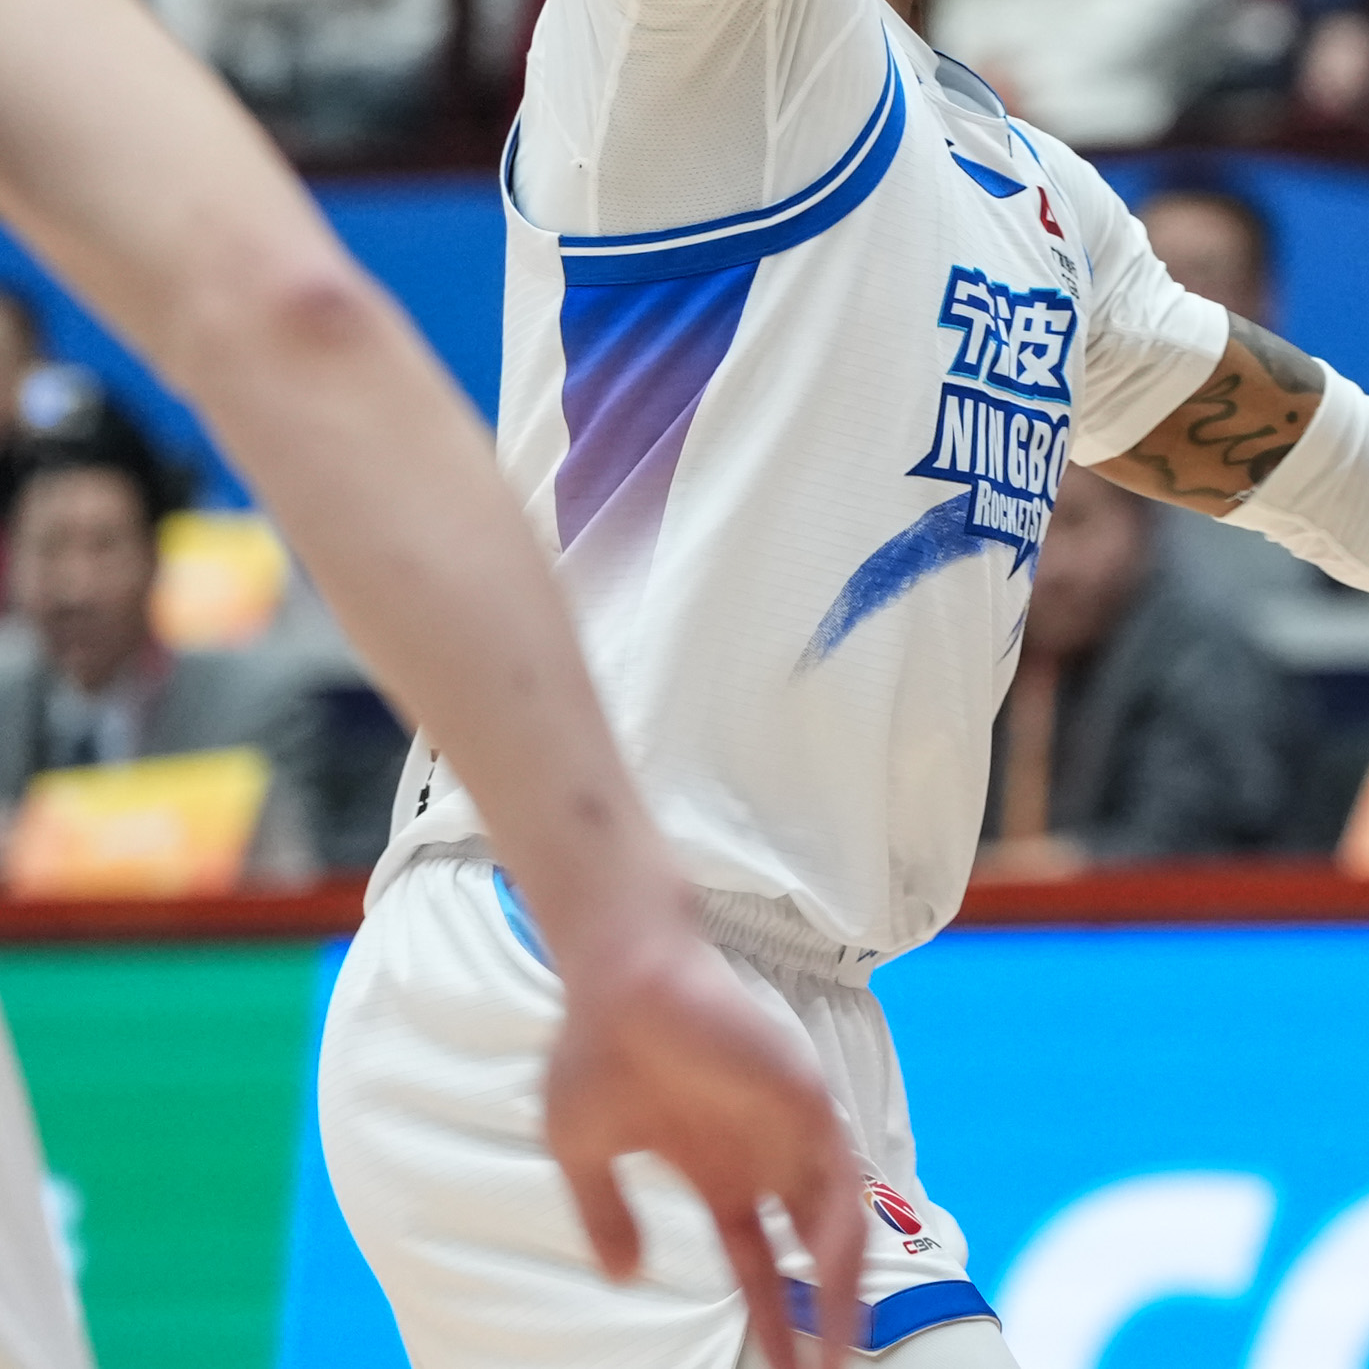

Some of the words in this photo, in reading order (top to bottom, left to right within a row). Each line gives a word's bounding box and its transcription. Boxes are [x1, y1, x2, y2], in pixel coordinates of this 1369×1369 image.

[951, 279, 1073, 389] 宁波
[932, 394, 1070, 504] NINGBO
[903, 1237, 942, 1255] CBA
